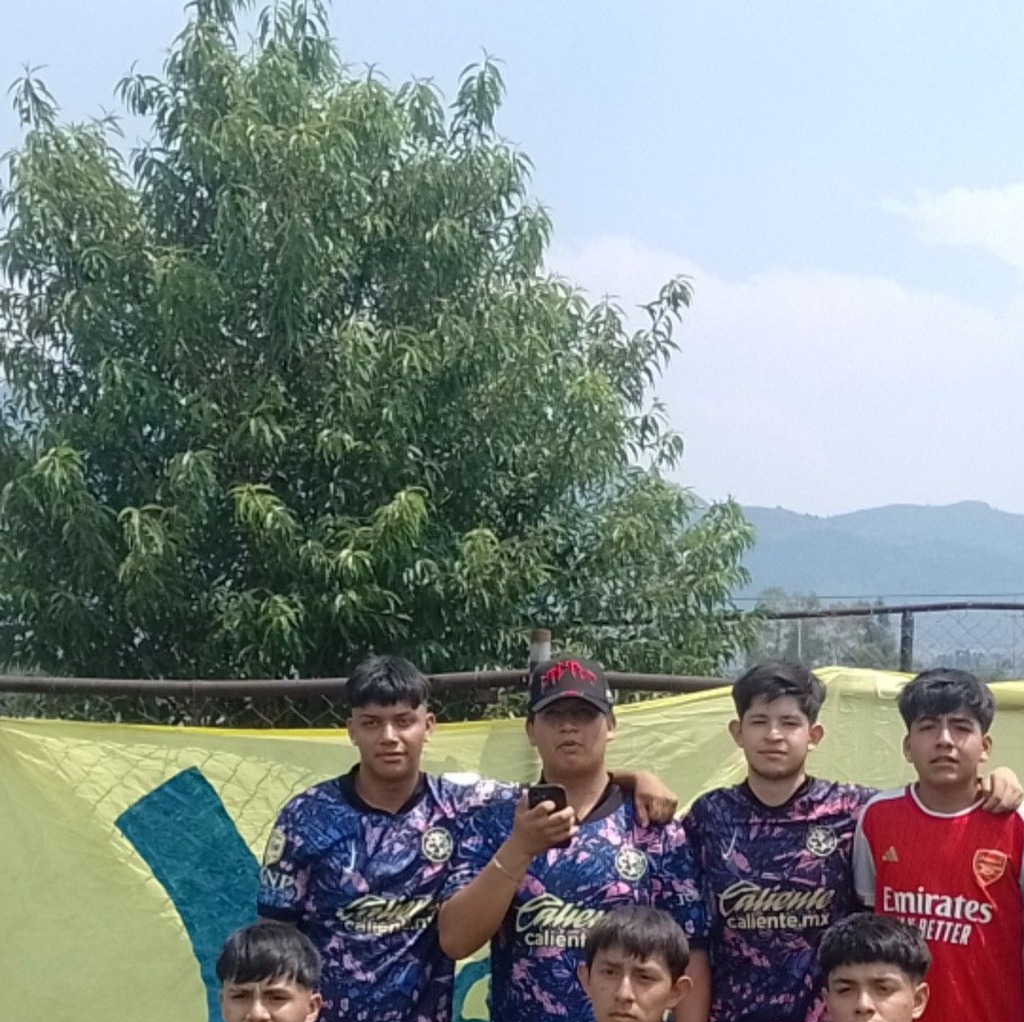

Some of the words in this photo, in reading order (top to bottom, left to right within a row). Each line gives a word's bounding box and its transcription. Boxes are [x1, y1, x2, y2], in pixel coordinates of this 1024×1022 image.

[718, 880, 835, 917] Caliente
[883, 885, 993, 924] Emirates
[726, 913, 830, 930] caliente.mx
[524, 929, 588, 948] calient
